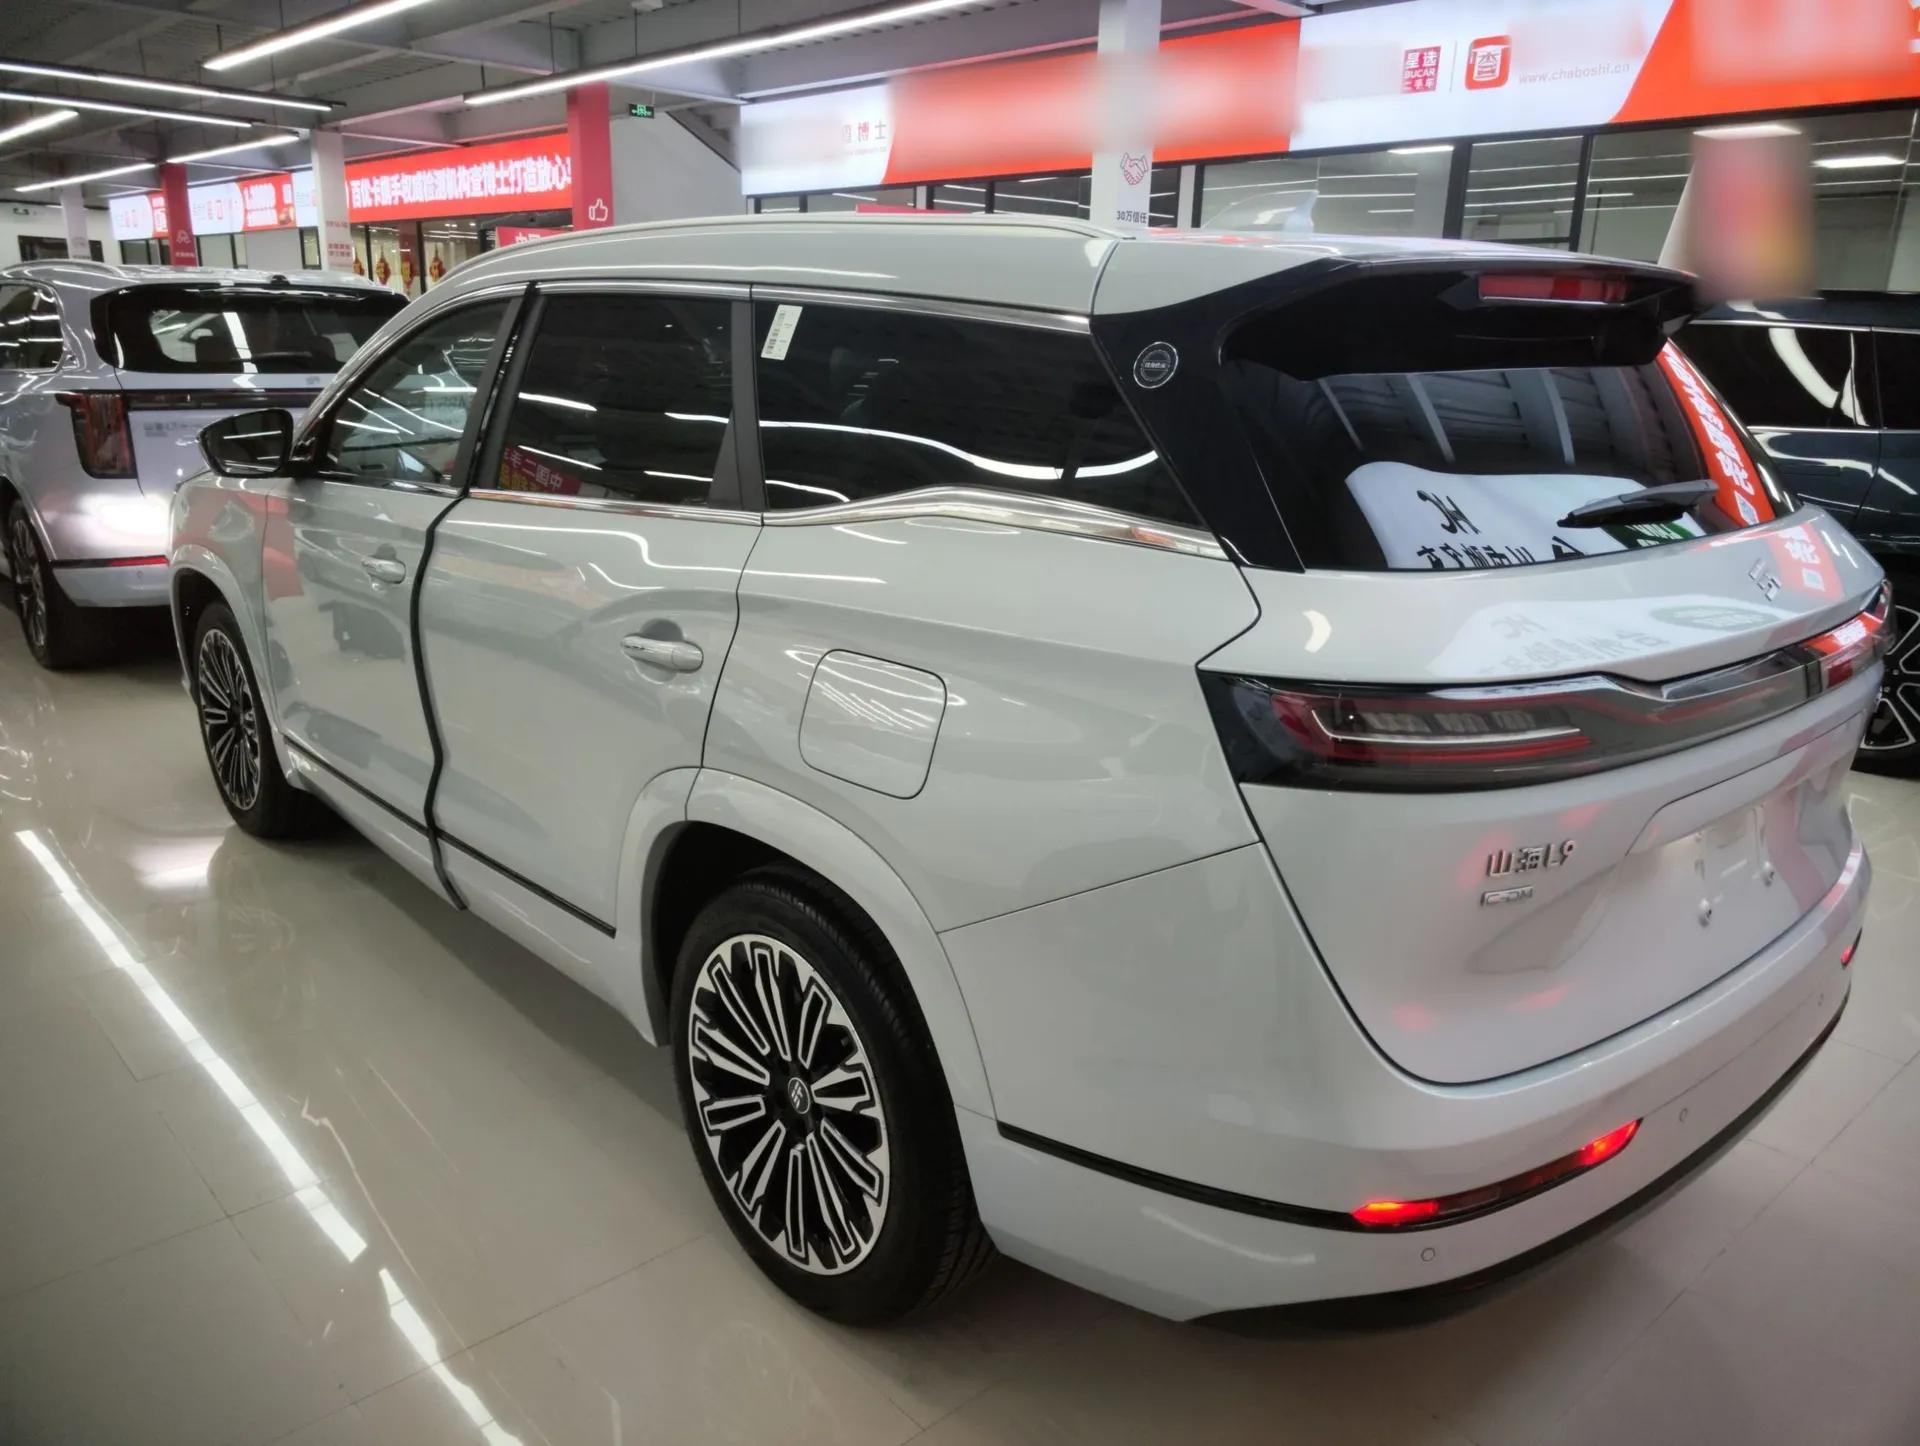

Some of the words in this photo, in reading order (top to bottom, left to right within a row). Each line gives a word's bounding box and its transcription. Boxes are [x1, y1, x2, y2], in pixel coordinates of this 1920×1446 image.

[1406, 51, 1438, 67] 星选
[1404, 68, 1437, 79] BUCAR
[1518, 62, 1630, 84] www.chaboshi.cn
[1116, 209, 1147, 224] 30万信任
